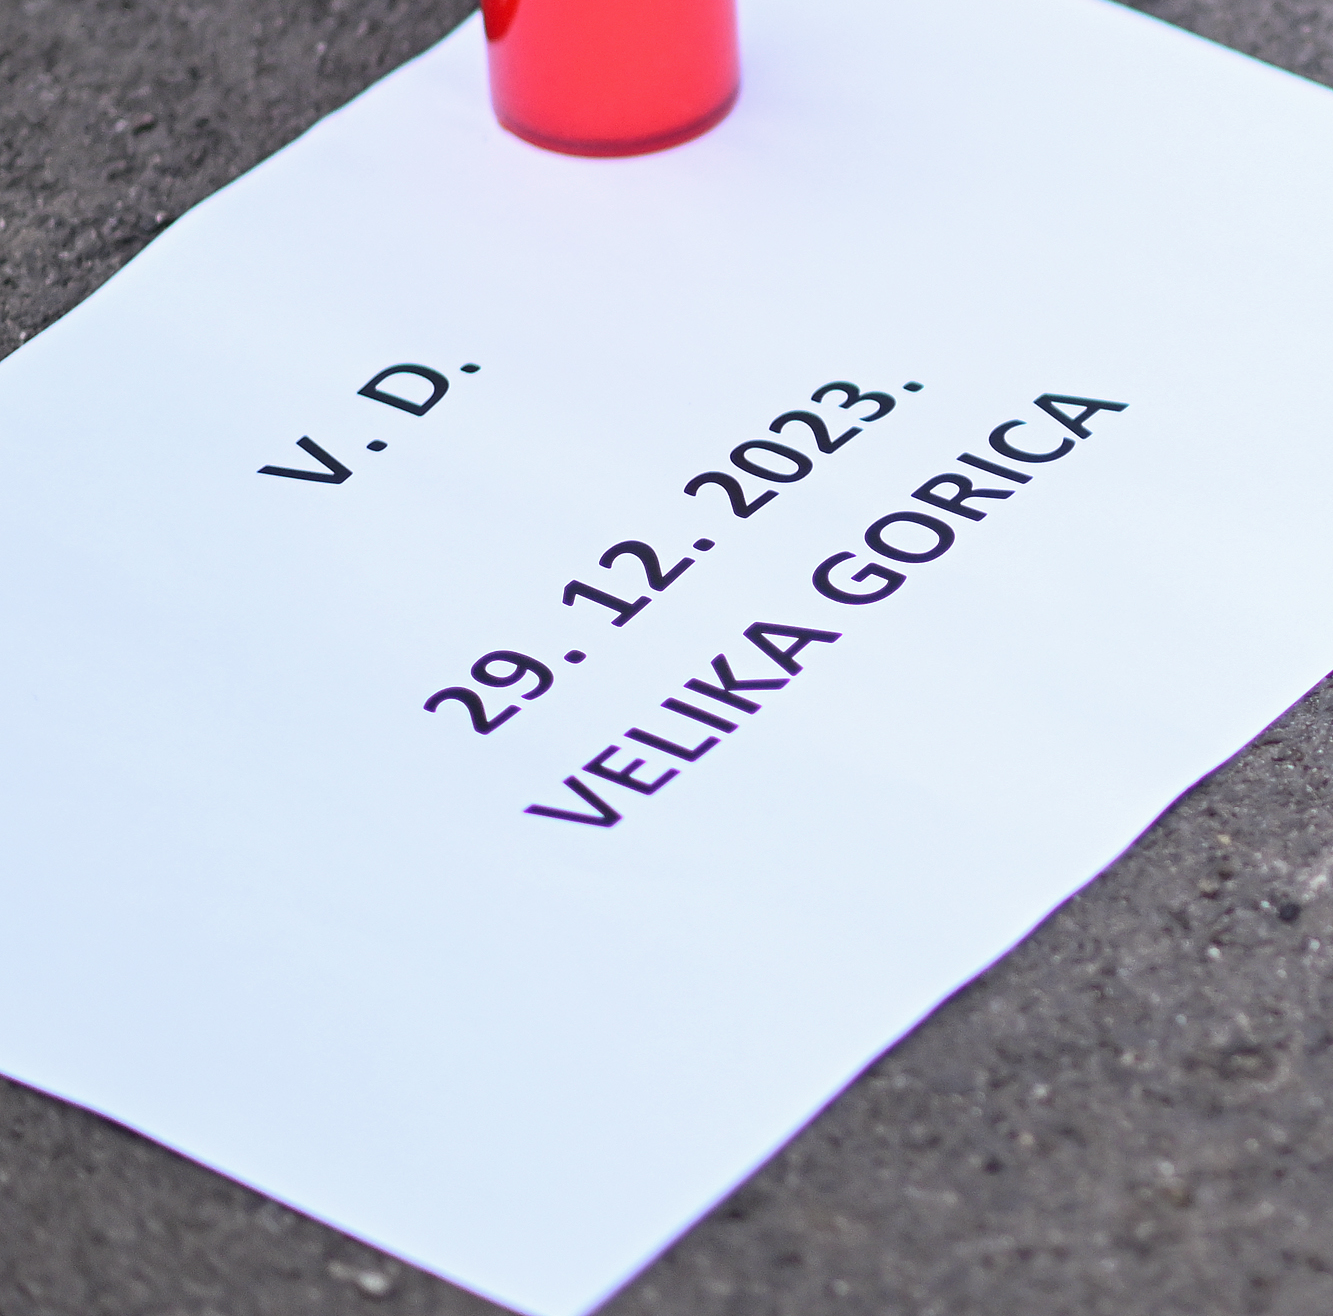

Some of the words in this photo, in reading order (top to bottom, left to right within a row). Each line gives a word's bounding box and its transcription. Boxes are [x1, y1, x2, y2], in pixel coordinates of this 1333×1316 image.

[257, 436, 388, 485] V.
[357, 362, 482, 417] D.
[423, 648, 588, 736] 29.
[561, 538, 716, 628] 12.
[683, 379, 925, 519] 2023.
[523, 620, 843, 828] VELIKA
[811, 391, 1130, 606] GORICA
